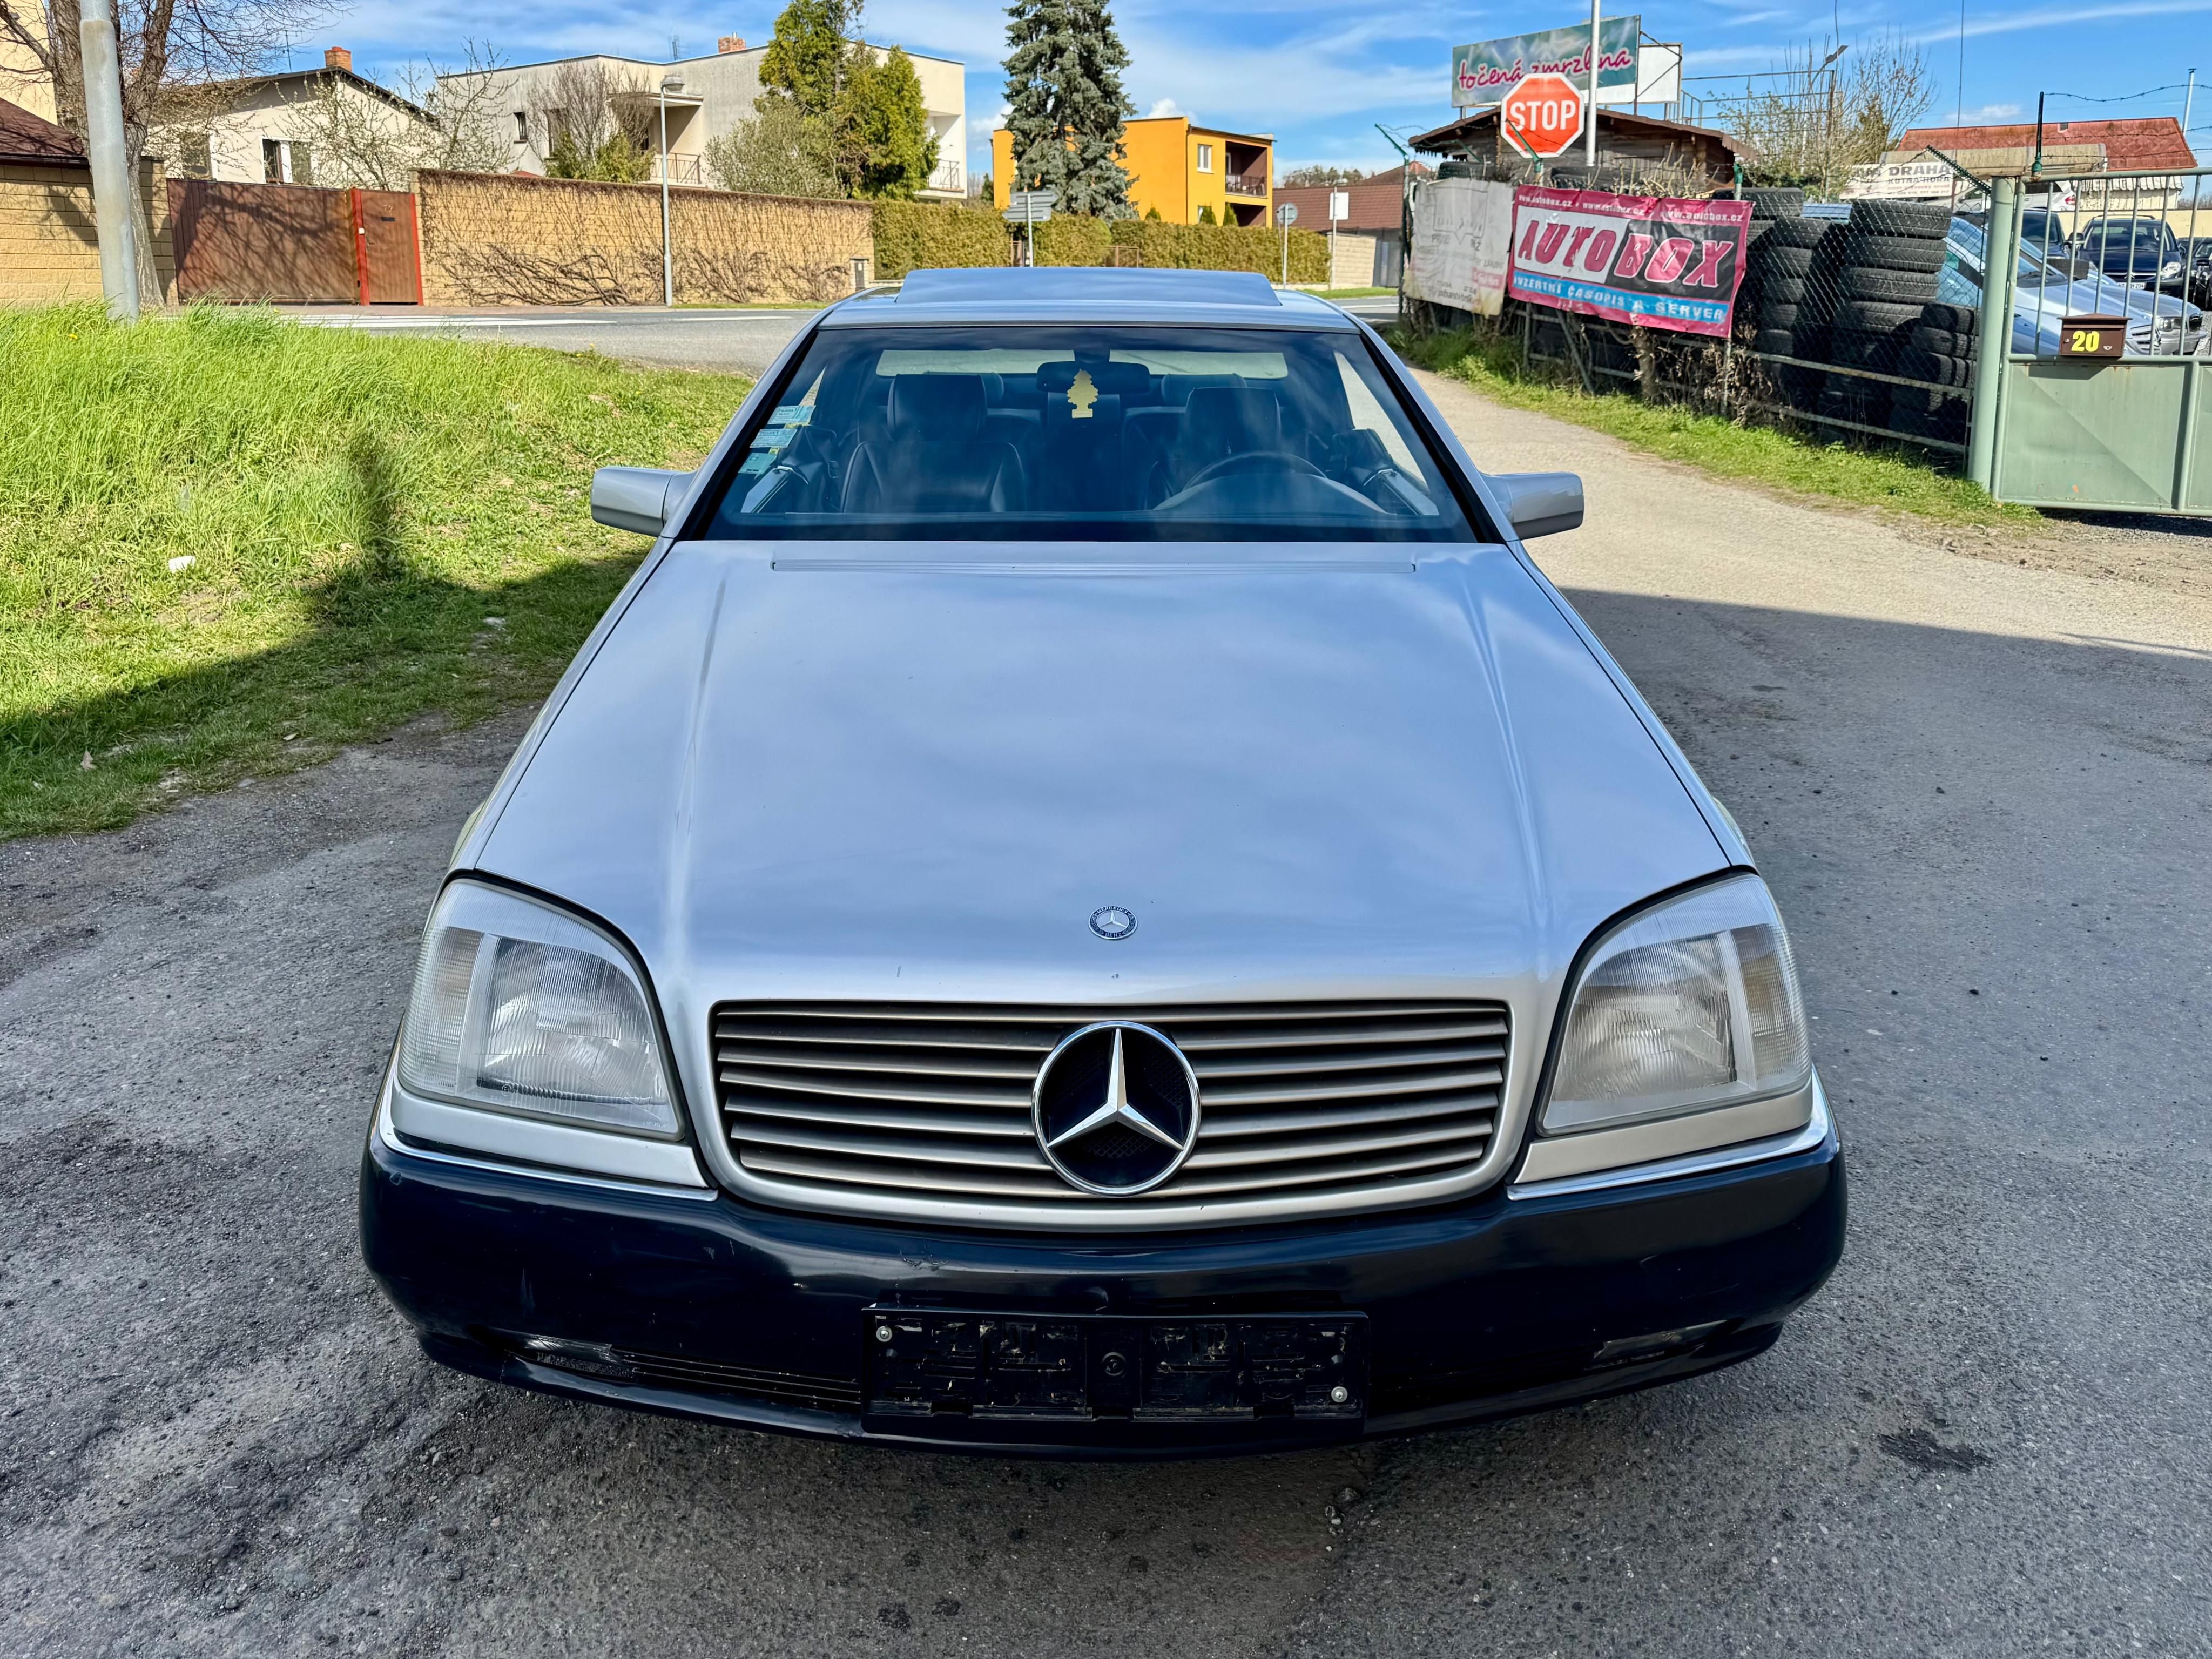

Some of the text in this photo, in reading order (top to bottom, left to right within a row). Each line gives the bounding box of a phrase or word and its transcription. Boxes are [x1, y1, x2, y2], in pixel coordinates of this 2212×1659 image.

[1459, 45, 1630, 88] točená zmrzlna
[1510, 100, 1576, 131] STOP
[1568, 285, 1624, 306] ČASOPIS
[1632, 300, 1644, 310] A
[1656, 301, 1723, 320] SERVER
[2071, 331, 2100, 352] 20
